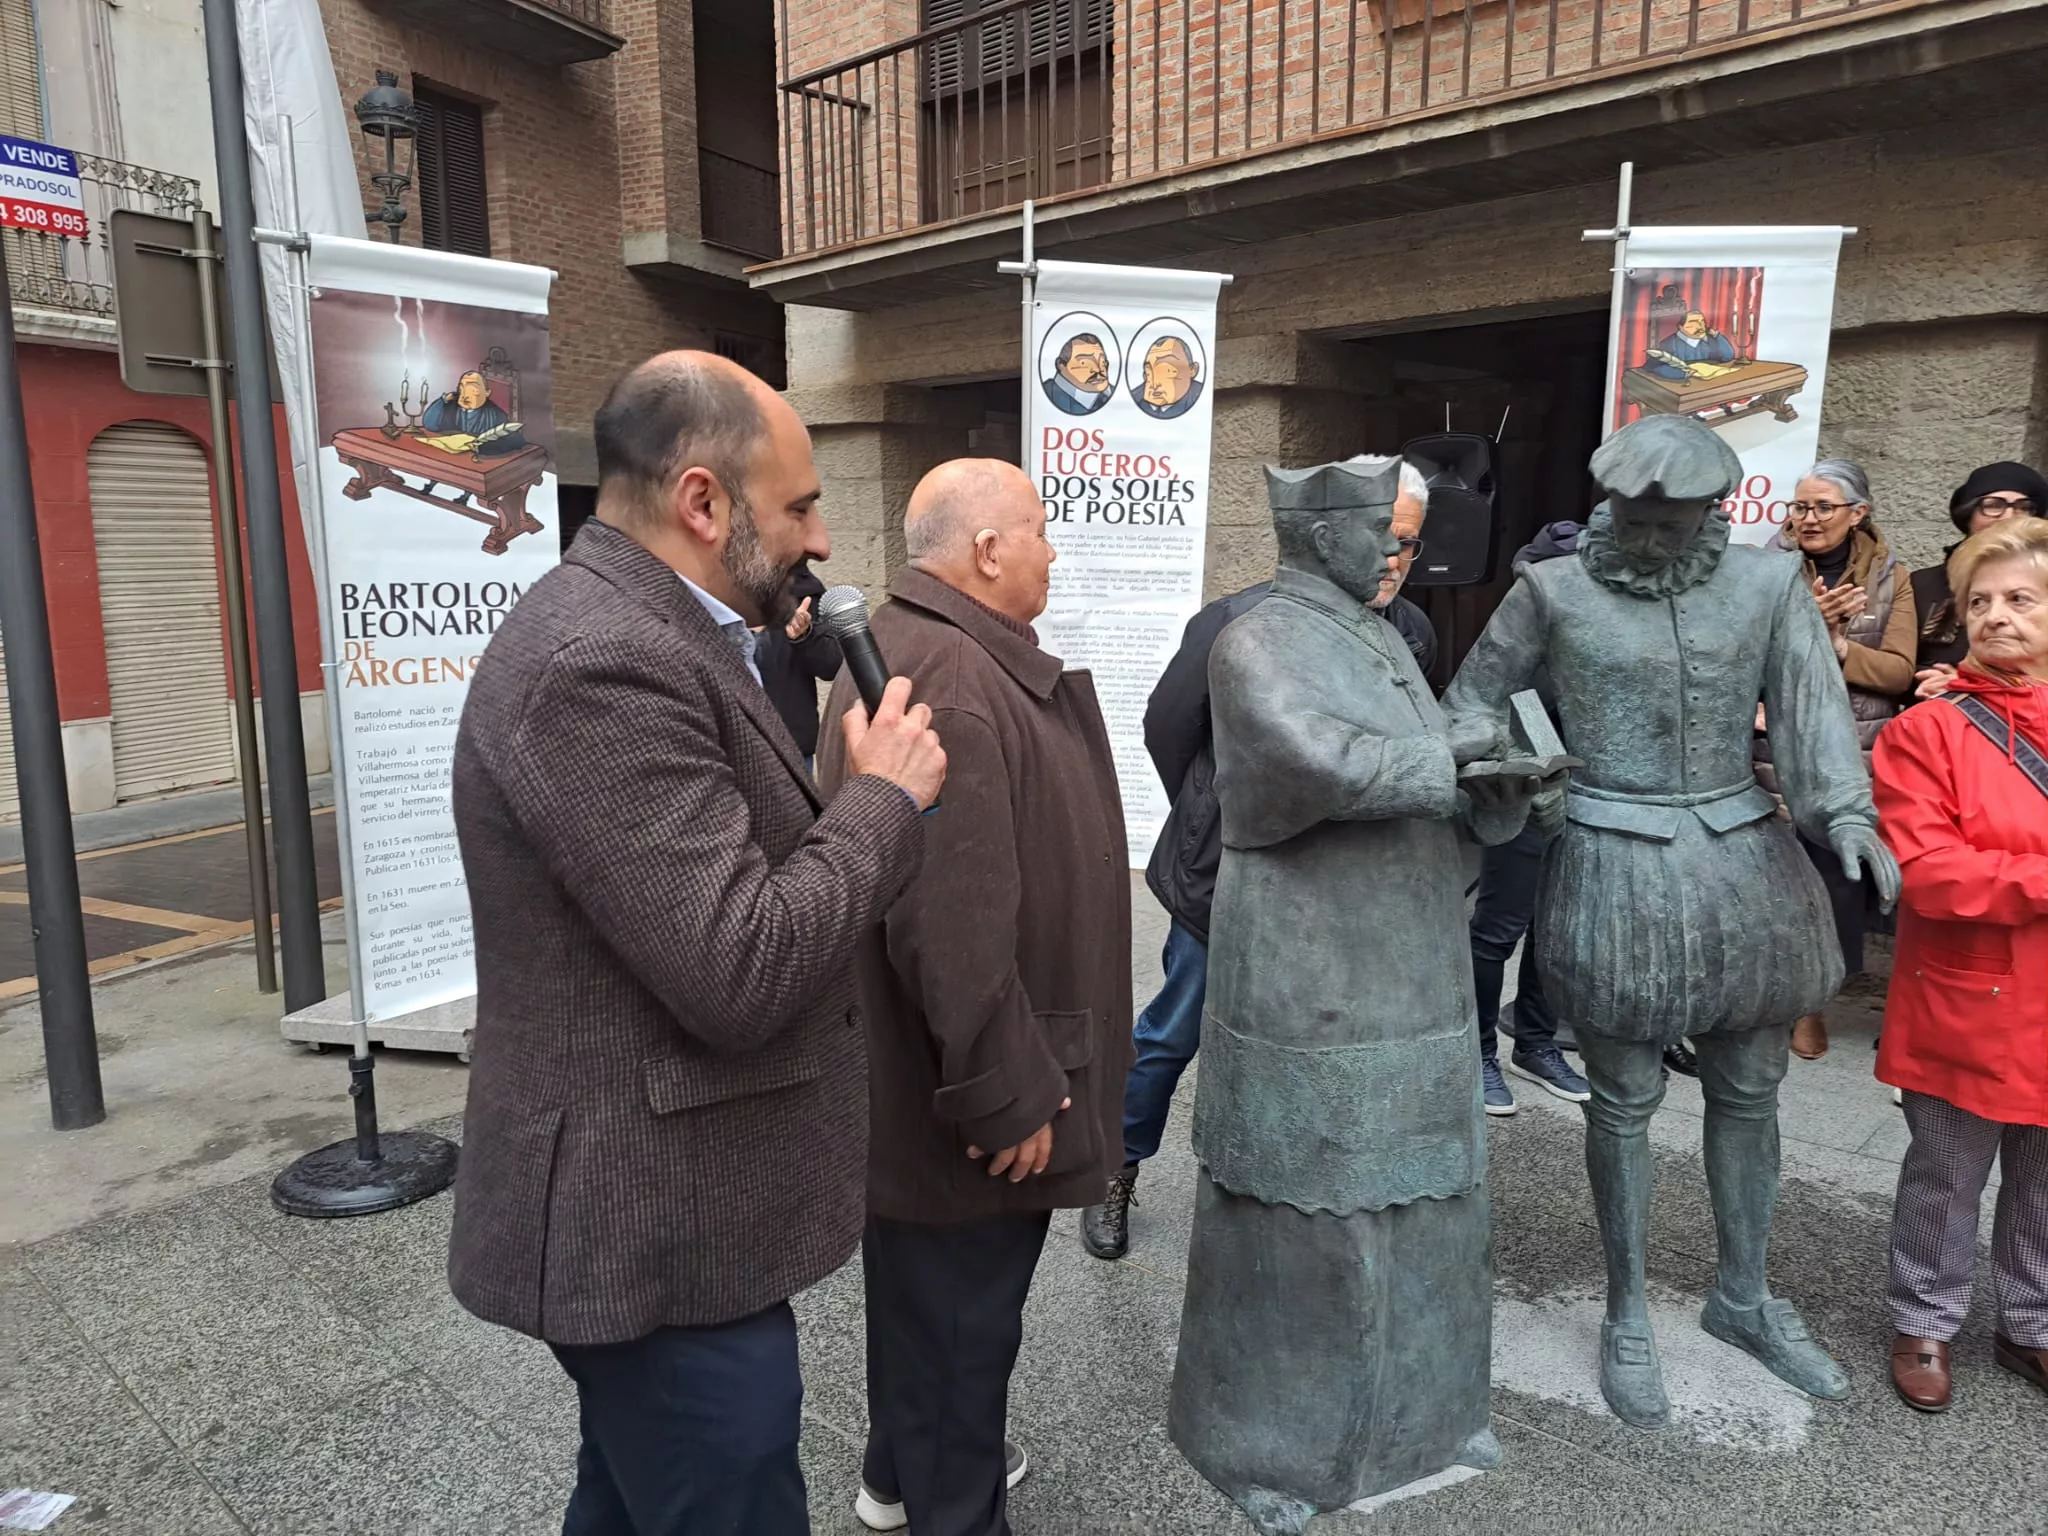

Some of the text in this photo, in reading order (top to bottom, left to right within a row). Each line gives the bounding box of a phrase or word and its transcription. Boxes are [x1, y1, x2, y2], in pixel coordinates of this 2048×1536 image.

[3, 143, 70, 172] VENDE
[13, 205, 48, 226] 308
[52, 212, 84, 232] 995
[1043, 427, 1105, 452] DOS
[1042, 452, 1179, 481] LUCEROS,
[1042, 475, 1102, 500] DOS
[1043, 500, 1075, 523] DE
[344, 640, 376, 662] DE
[354, 706, 454, 720] Bartolomé nació en
[354, 723, 387, 733] realizó
[388, 720, 426, 731] estudios
[356, 748, 397, 759] Trabajó
[406, 745, 416, 755] al
[357, 760, 418, 772] Villahermosa
[420, 756, 448, 766] como
[358, 772, 420, 785] Villahermosa
[424, 768, 438, 778] del
[360, 787, 408, 799] emperatriz
[410, 782, 438, 792] María
[360, 803, 377, 813] que
[361, 814, 396, 824] servicio
[398, 809, 412, 819] del
[414, 808, 441, 818] virrey
[364, 842, 374, 850] En
[377, 836, 400, 848] 1615
[414, 828, 458, 842] nombrad
[364, 843, 456, 864] Zaragoza y cronista
[365, 864, 398, 876] Publica
[400, 862, 411, 870] en
[414, 858, 436, 869] 1631
[438, 855, 452, 865] los
[367, 893, 378, 902] En
[382, 888, 404, 898] 1631
[408, 884, 437, 894] muere
[368, 906, 379, 915] en
[380, 904, 388, 912] la
[370, 931, 385, 941] Sus
[390, 922, 422, 938] poesías
[427, 920, 444, 930] que
[370, 940, 405, 954] durante
[412, 936, 423, 944] su
[372, 948, 420, 968] publicadas
[422, 944, 436, 956] por
[438, 942, 449, 951] su
[373, 966, 397, 980] junto
[411, 960, 422, 970] las
[426, 952, 458, 968] poesías
[374, 980, 402, 992] Rimas
[406, 976, 418, 984] en
